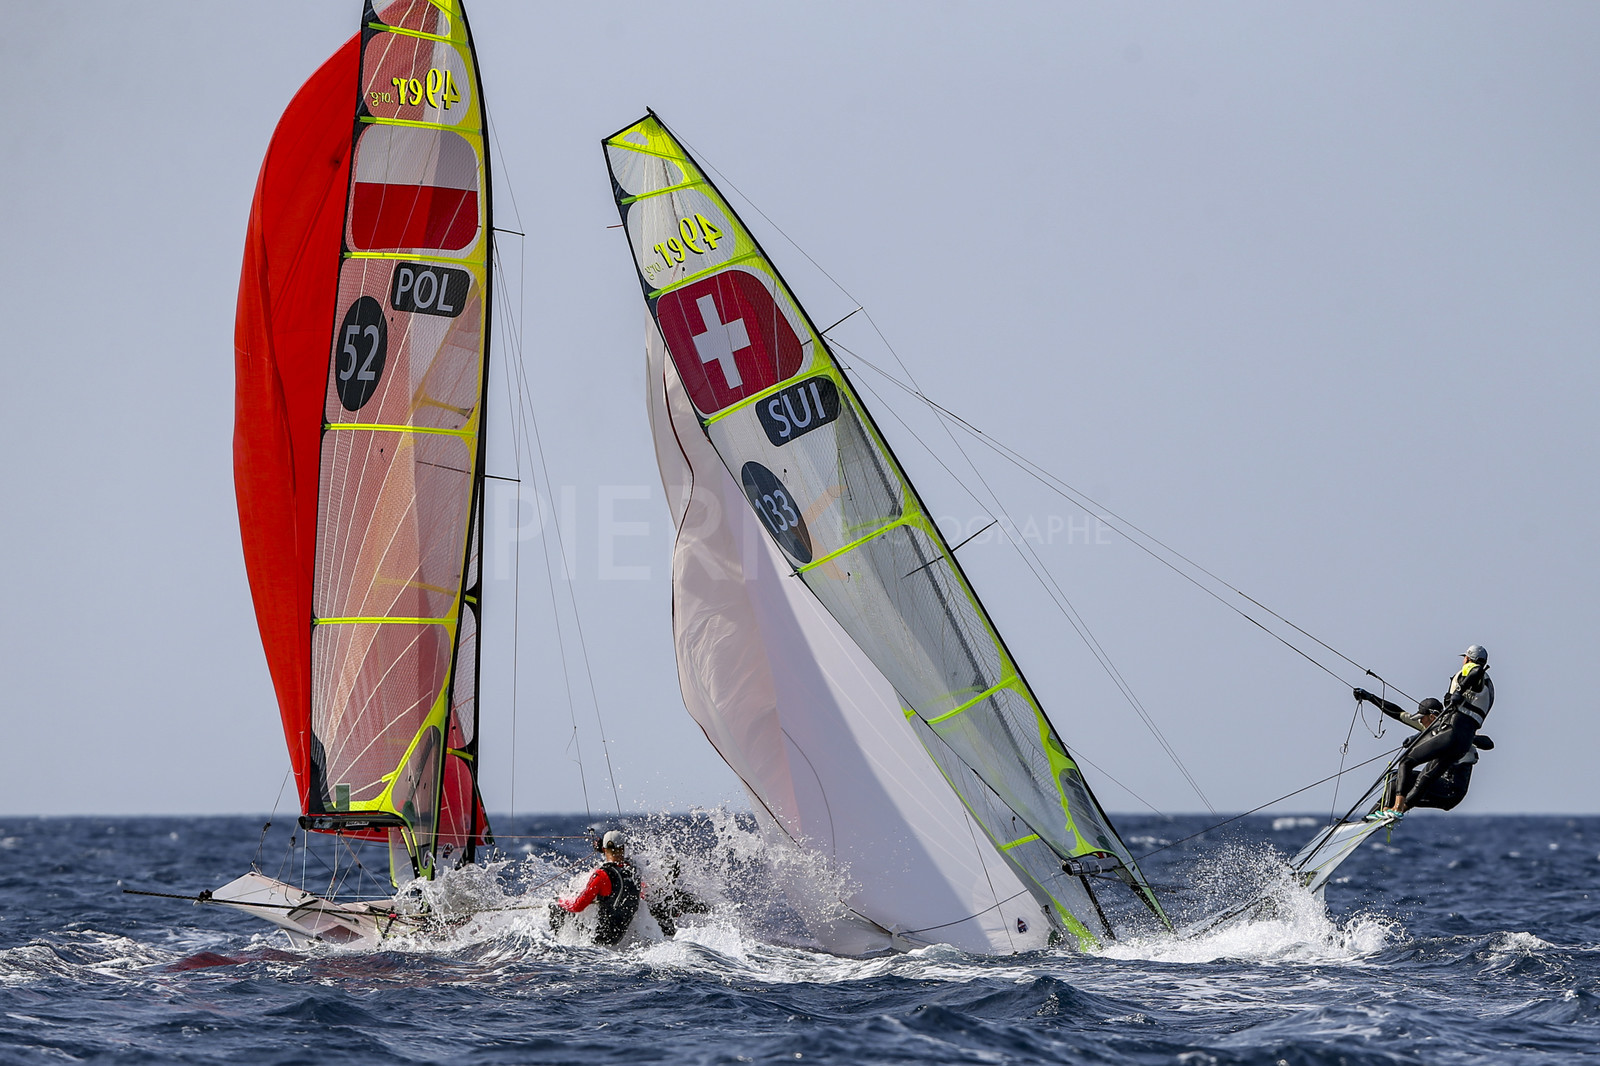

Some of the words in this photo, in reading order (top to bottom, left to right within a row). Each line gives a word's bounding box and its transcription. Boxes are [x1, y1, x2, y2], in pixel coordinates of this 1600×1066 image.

[395, 268, 453, 312] POL
[339, 324, 380, 381] 52
[768, 382, 826, 437] SUI
[755, 489, 799, 534] 133
